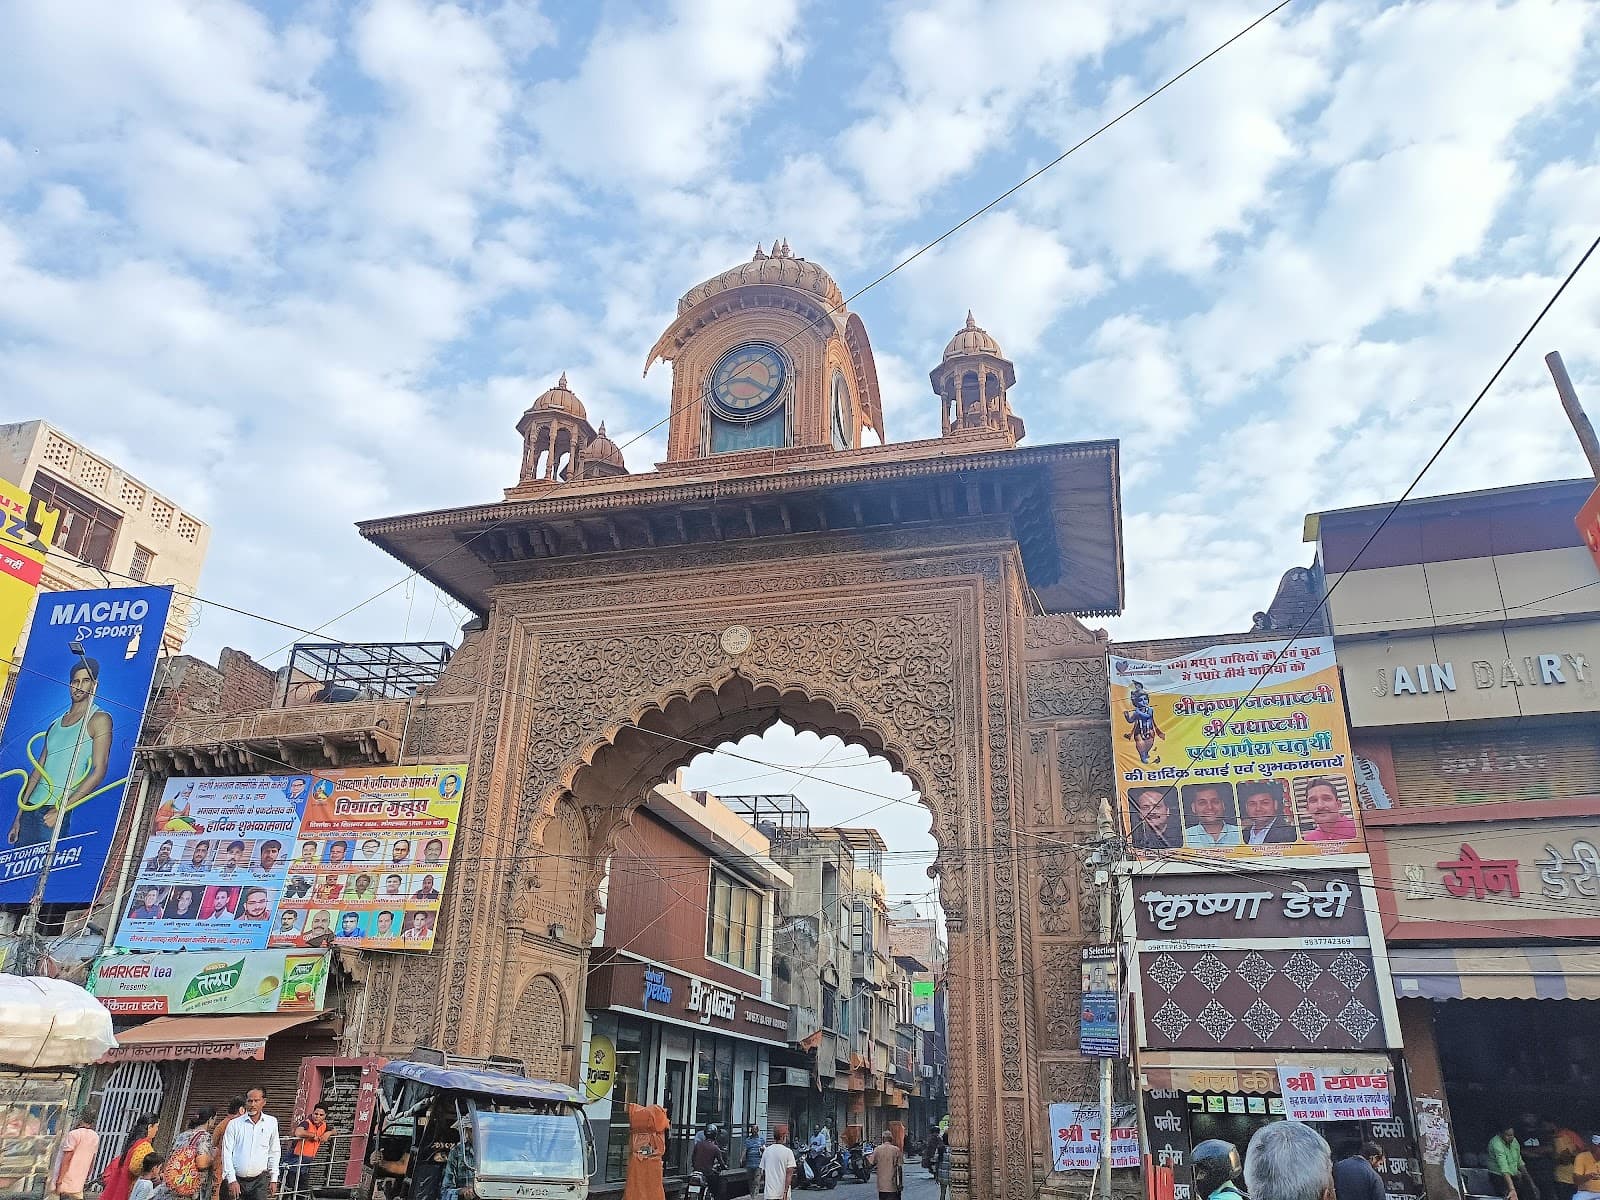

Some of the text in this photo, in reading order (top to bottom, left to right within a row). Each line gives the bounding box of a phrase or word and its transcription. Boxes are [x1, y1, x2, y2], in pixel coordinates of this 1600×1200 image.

[4, 556, 24, 571] नहीं
[50, 600, 149, 626] MACHO
[1190, 656, 1218, 671] मथुरा
[1220, 650, 1260, 664] वासियों
[1262, 649, 1277, 661] को
[1290, 661, 1305, 673] को
[1371, 653, 1590, 698] JAIN DAIRY
[1173, 685, 1334, 716] श्रीकृष्ण जन्माष्टमी
[1203, 713, 1310, 738] श्री राधाष्टमी
[1186, 731, 1333, 760] एवं गणेश चतुर्थी
[1124, 769, 1143, 782] की
[1146, 766, 1190, 782] हार्दिक
[1233, 762, 1255, 776] एवं
[1258, 754, 1345, 776] शुभकामनायें
[335, 798, 429, 817] विशाल जुलूस
[206, 817, 296, 837] हार्दिक शुभकामनायें
[1437, 840, 1600, 901] जैन डेरी
[1140, 880, 1353, 931] कृष्णा डेरी
[99, 964, 172, 978] MARKER tea
[119, 982, 148, 991] Presents
[106, 998, 165, 1013] किराना स्टोर
[131, 1044, 170, 1057] किराना
[174, 1041, 234, 1056] एम्पोरियम
[1286, 1072, 1388, 1092] श्री खण्ड
[1154, 1109, 1182, 1132] पनीर
[1371, 1115, 1405, 1138] लस्सी
[1058, 1124, 1083, 1142] श्री
[1157, 1143, 1183, 1166] क्रीम
